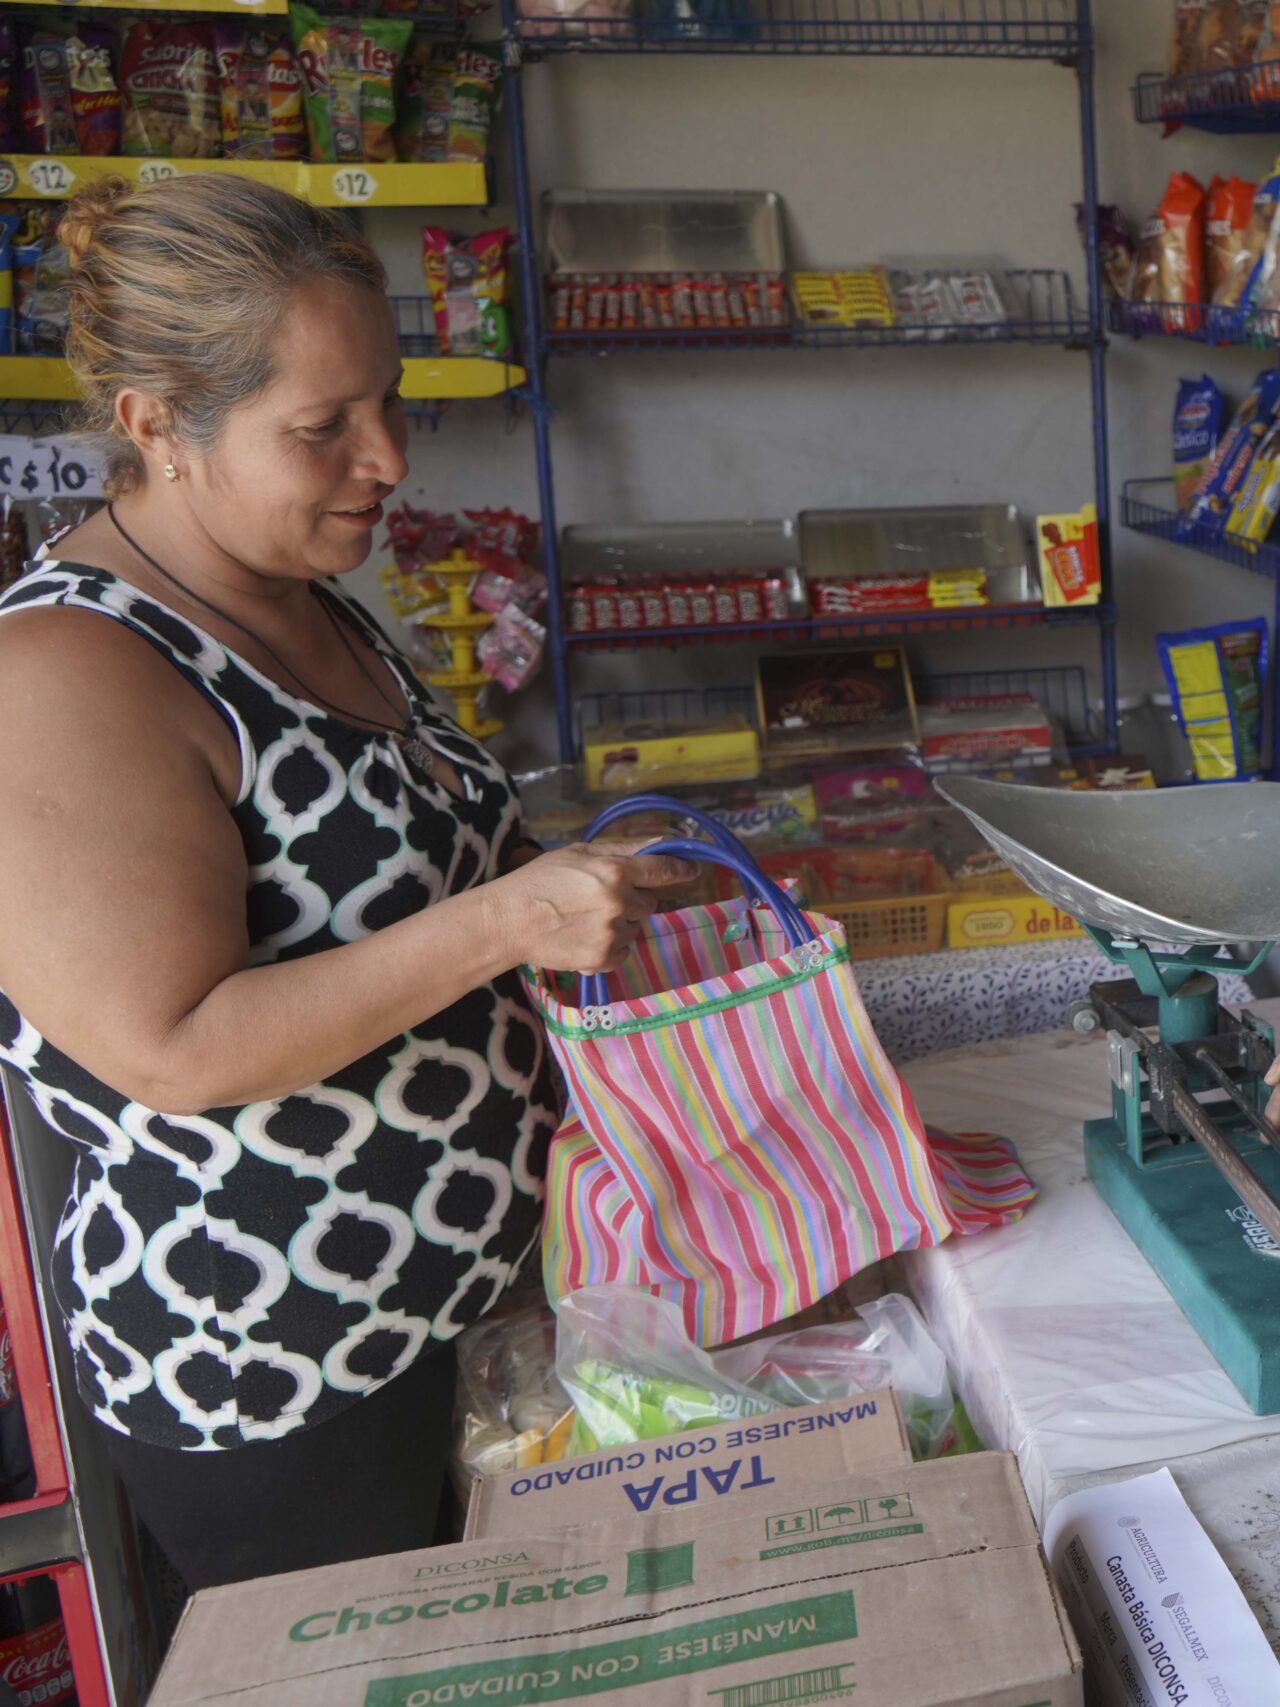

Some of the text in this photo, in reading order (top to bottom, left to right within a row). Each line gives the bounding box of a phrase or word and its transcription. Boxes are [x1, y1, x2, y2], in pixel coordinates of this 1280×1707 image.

[217, 52, 299, 85] Satas
[30, 166, 67, 189] $12
[335, 174, 371, 195] $12
[1026, 908, 1050, 934] de
[1053, 905, 1074, 931] la
[726, 1400, 878, 1448] MANEJESE
[655, 1437, 717, 1464] CON
[510, 1453, 645, 1497] CUIDADO
[621, 1455, 776, 1512] TAPA
[766, 1524, 916, 1558] www.gob.mx/diconsa
[397, 1587, 429, 1598] PARA
[431, 1577, 492, 1593] PREPARAR
[537, 1566, 563, 1576] CON
[414, 1551, 530, 1578] DICONSA
[288, 1573, 609, 1643] Chocolate
[1131, 1527, 1168, 1584] AGRICULTURA
[1172, 1606, 1210, 1663] SEGALMEX
[1068, 1540, 1153, 1707] Producto Marca Presentaci
[1106, 1554, 1190, 1707] Canasta Básica DICONSA
[405, 1614, 817, 1707] MANÉJESE CON CUIDADO
